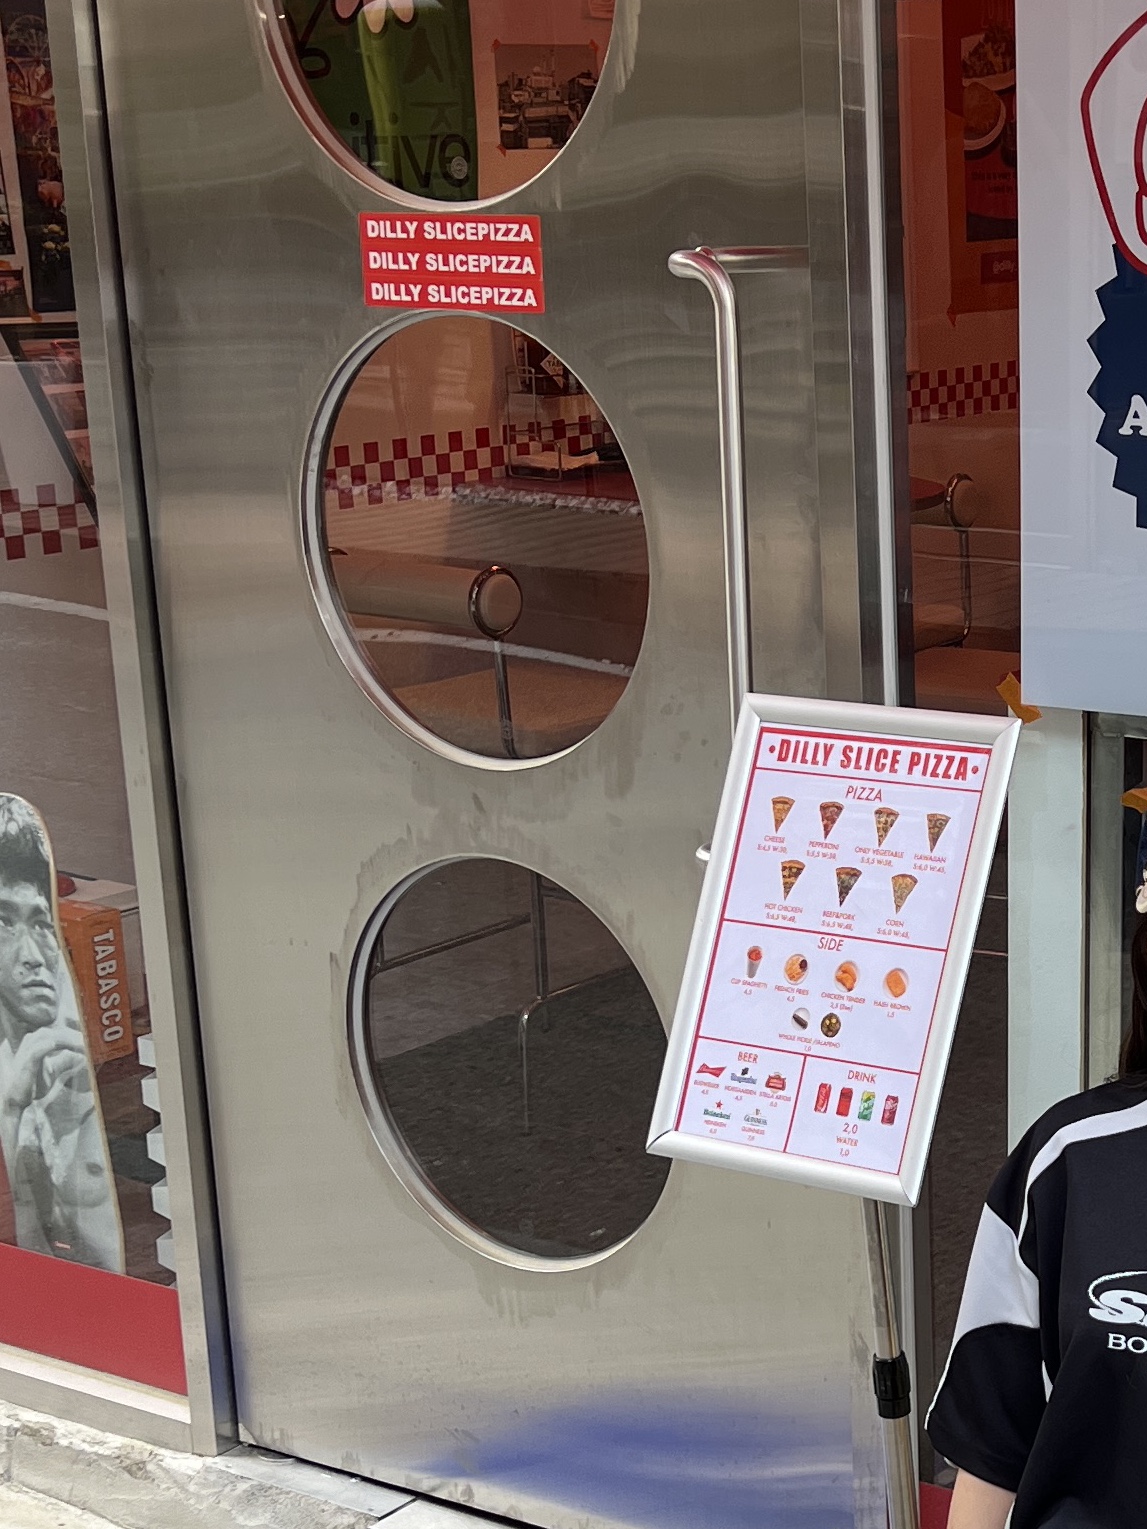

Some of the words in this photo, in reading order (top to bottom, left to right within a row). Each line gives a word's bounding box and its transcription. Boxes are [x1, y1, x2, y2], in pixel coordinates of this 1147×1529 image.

[366, 220, 418, 239] DILLY
[423, 221, 534, 242] SLICEPIZZA
[369, 251, 420, 270] DILLY
[425, 253, 536, 275] SLICEPIZZA
[371, 282, 422, 302] DILLY
[427, 285, 537, 307] SLICEPIZZA
[776, 738, 835, 767] DILLY
[840, 745, 902, 774] SLICE
[907, 752, 969, 781] PIZZA
[845, 785, 883, 803] PIZZA
[886, 919, 905, 928] CORN
[817, 936, 844, 952] SIDE
[93, 928, 124, 1043] TABASCO
[737, 1051, 758, 1064] BEER
[848, 1070, 877, 1084] DRINK
[836, 1136, 859, 1147] WATER
